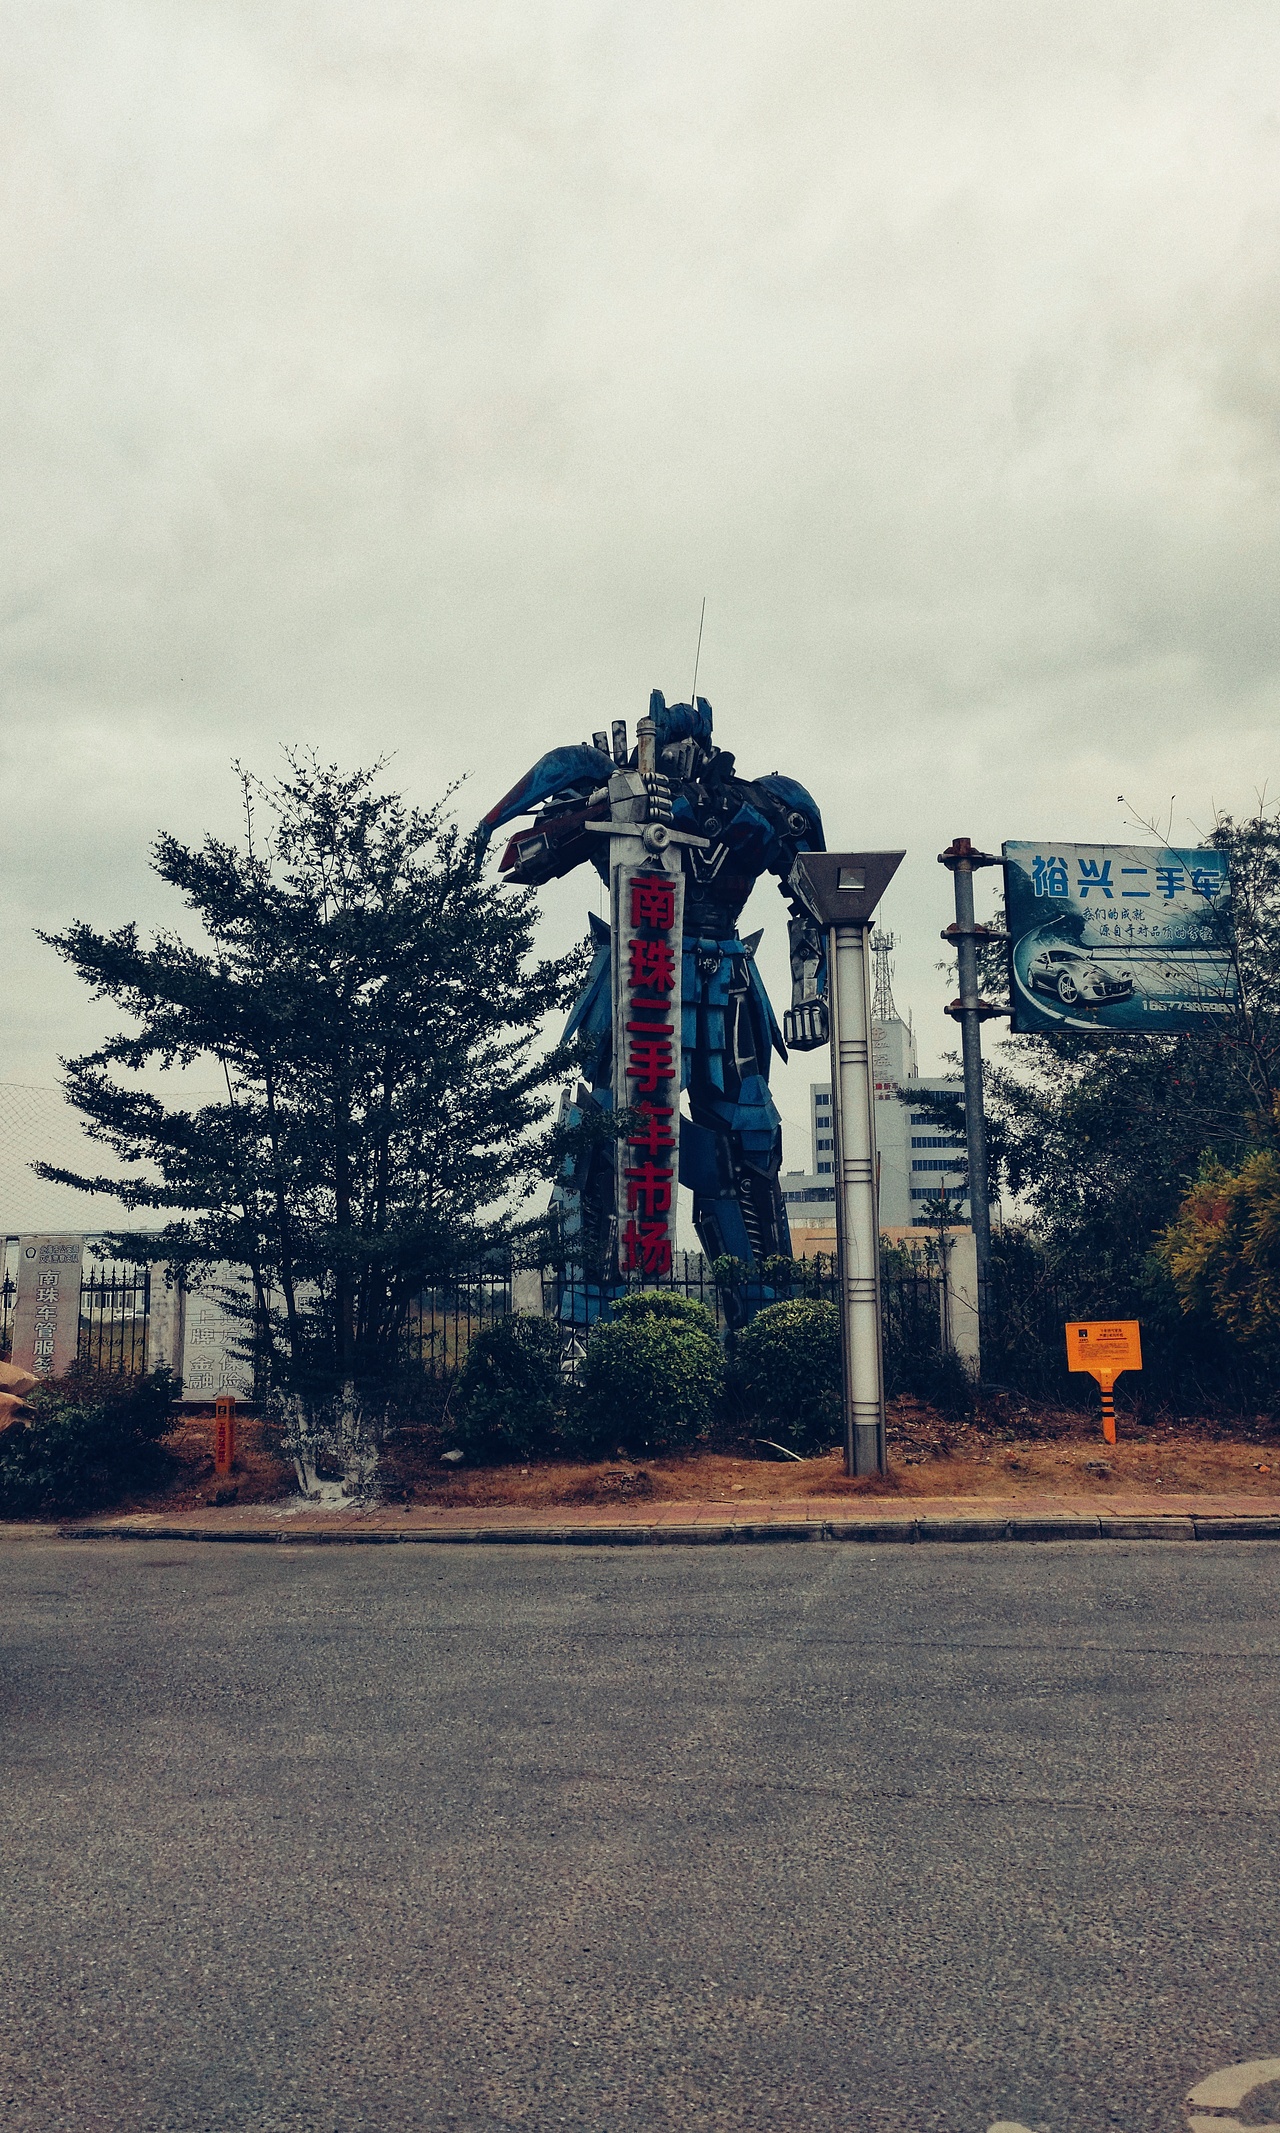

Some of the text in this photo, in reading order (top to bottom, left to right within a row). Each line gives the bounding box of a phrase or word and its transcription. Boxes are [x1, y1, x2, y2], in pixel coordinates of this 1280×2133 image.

[1031, 855, 1223, 899] 裕兴二手车
[1082, 907, 1146, 921] 我们的成就
[621, 874, 677, 1275] 南珠二手车市场
[190, 1310, 215, 1345] 上牌
[188, 1355, 215, 1389] 金融
